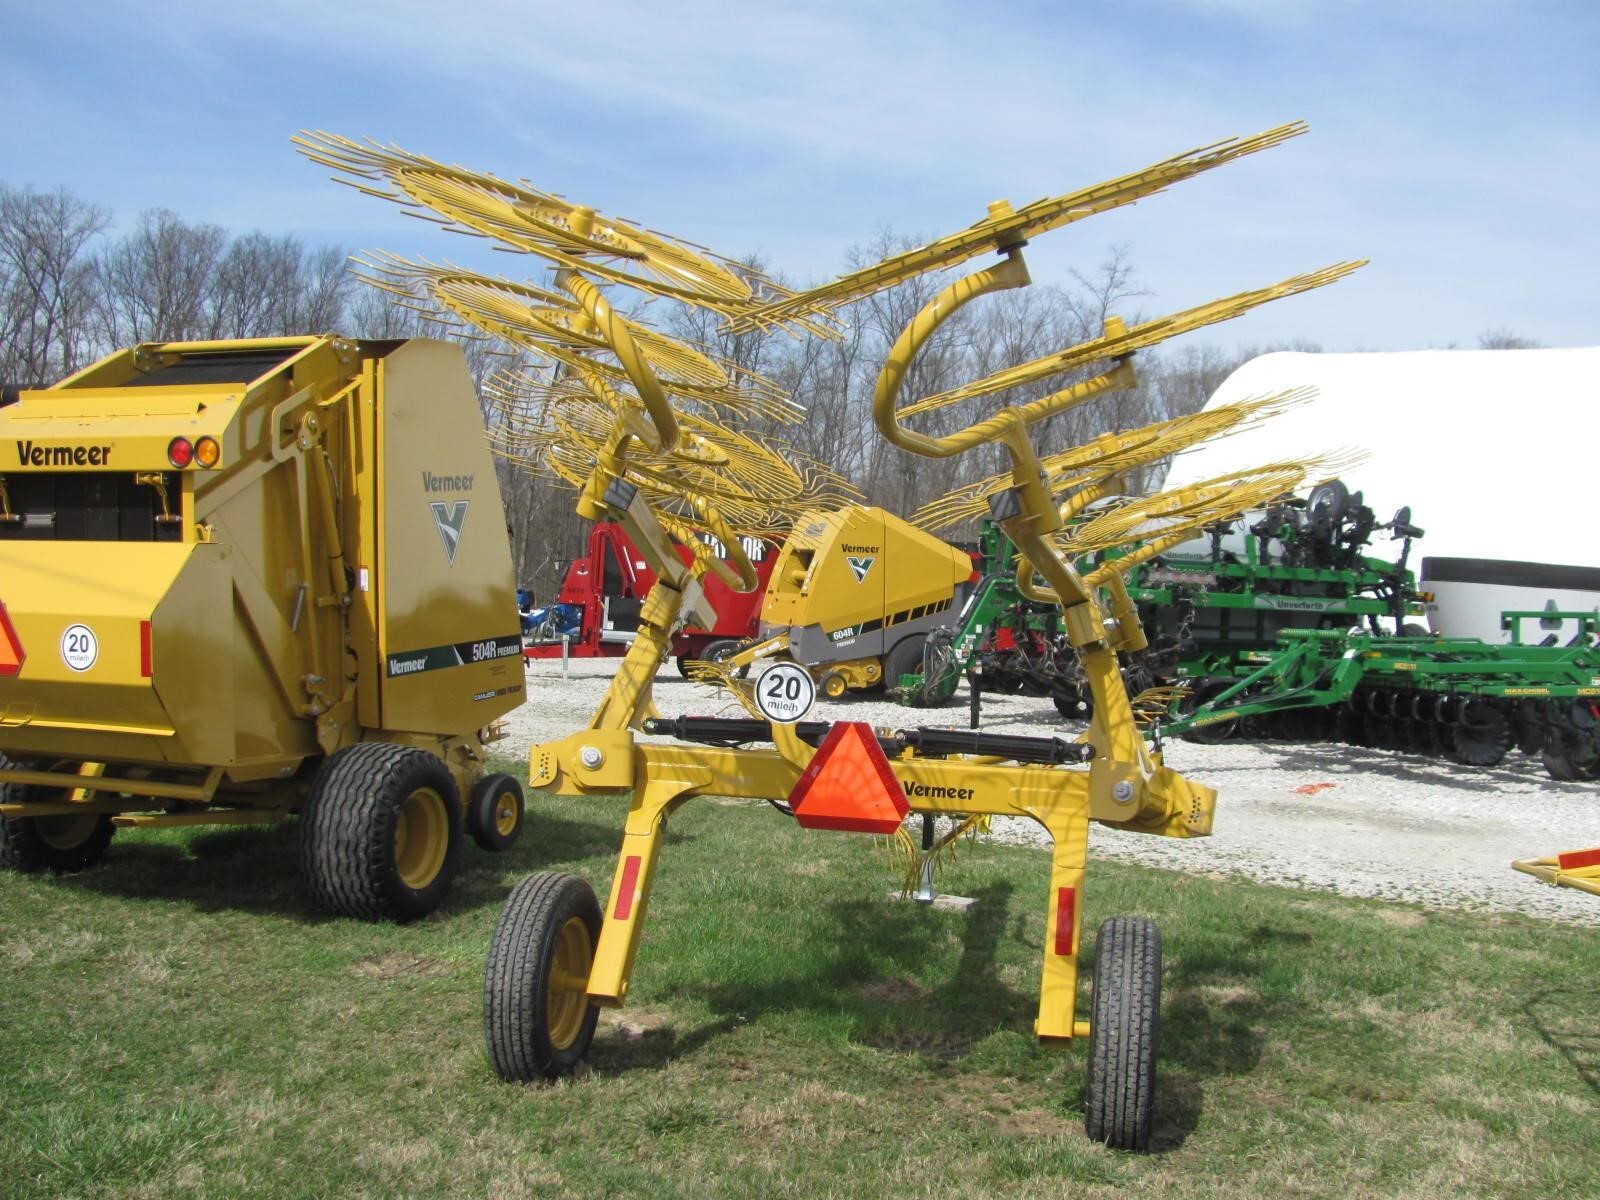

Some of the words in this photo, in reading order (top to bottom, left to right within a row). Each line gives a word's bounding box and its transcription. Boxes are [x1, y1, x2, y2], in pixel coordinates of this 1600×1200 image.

[17, 440, 112, 466] Vermeer
[422, 471, 475, 492] Vermeer
[841, 543, 880, 554] Vermeer
[68, 633, 90, 654] 20
[832, 627, 855, 641] 604R
[472, 640, 497, 661] 504R
[390, 657, 427, 675] Vermeer
[767, 673, 801, 701] 20
[767, 700, 799, 713] mile/h
[903, 780, 975, 801] Vermeer
